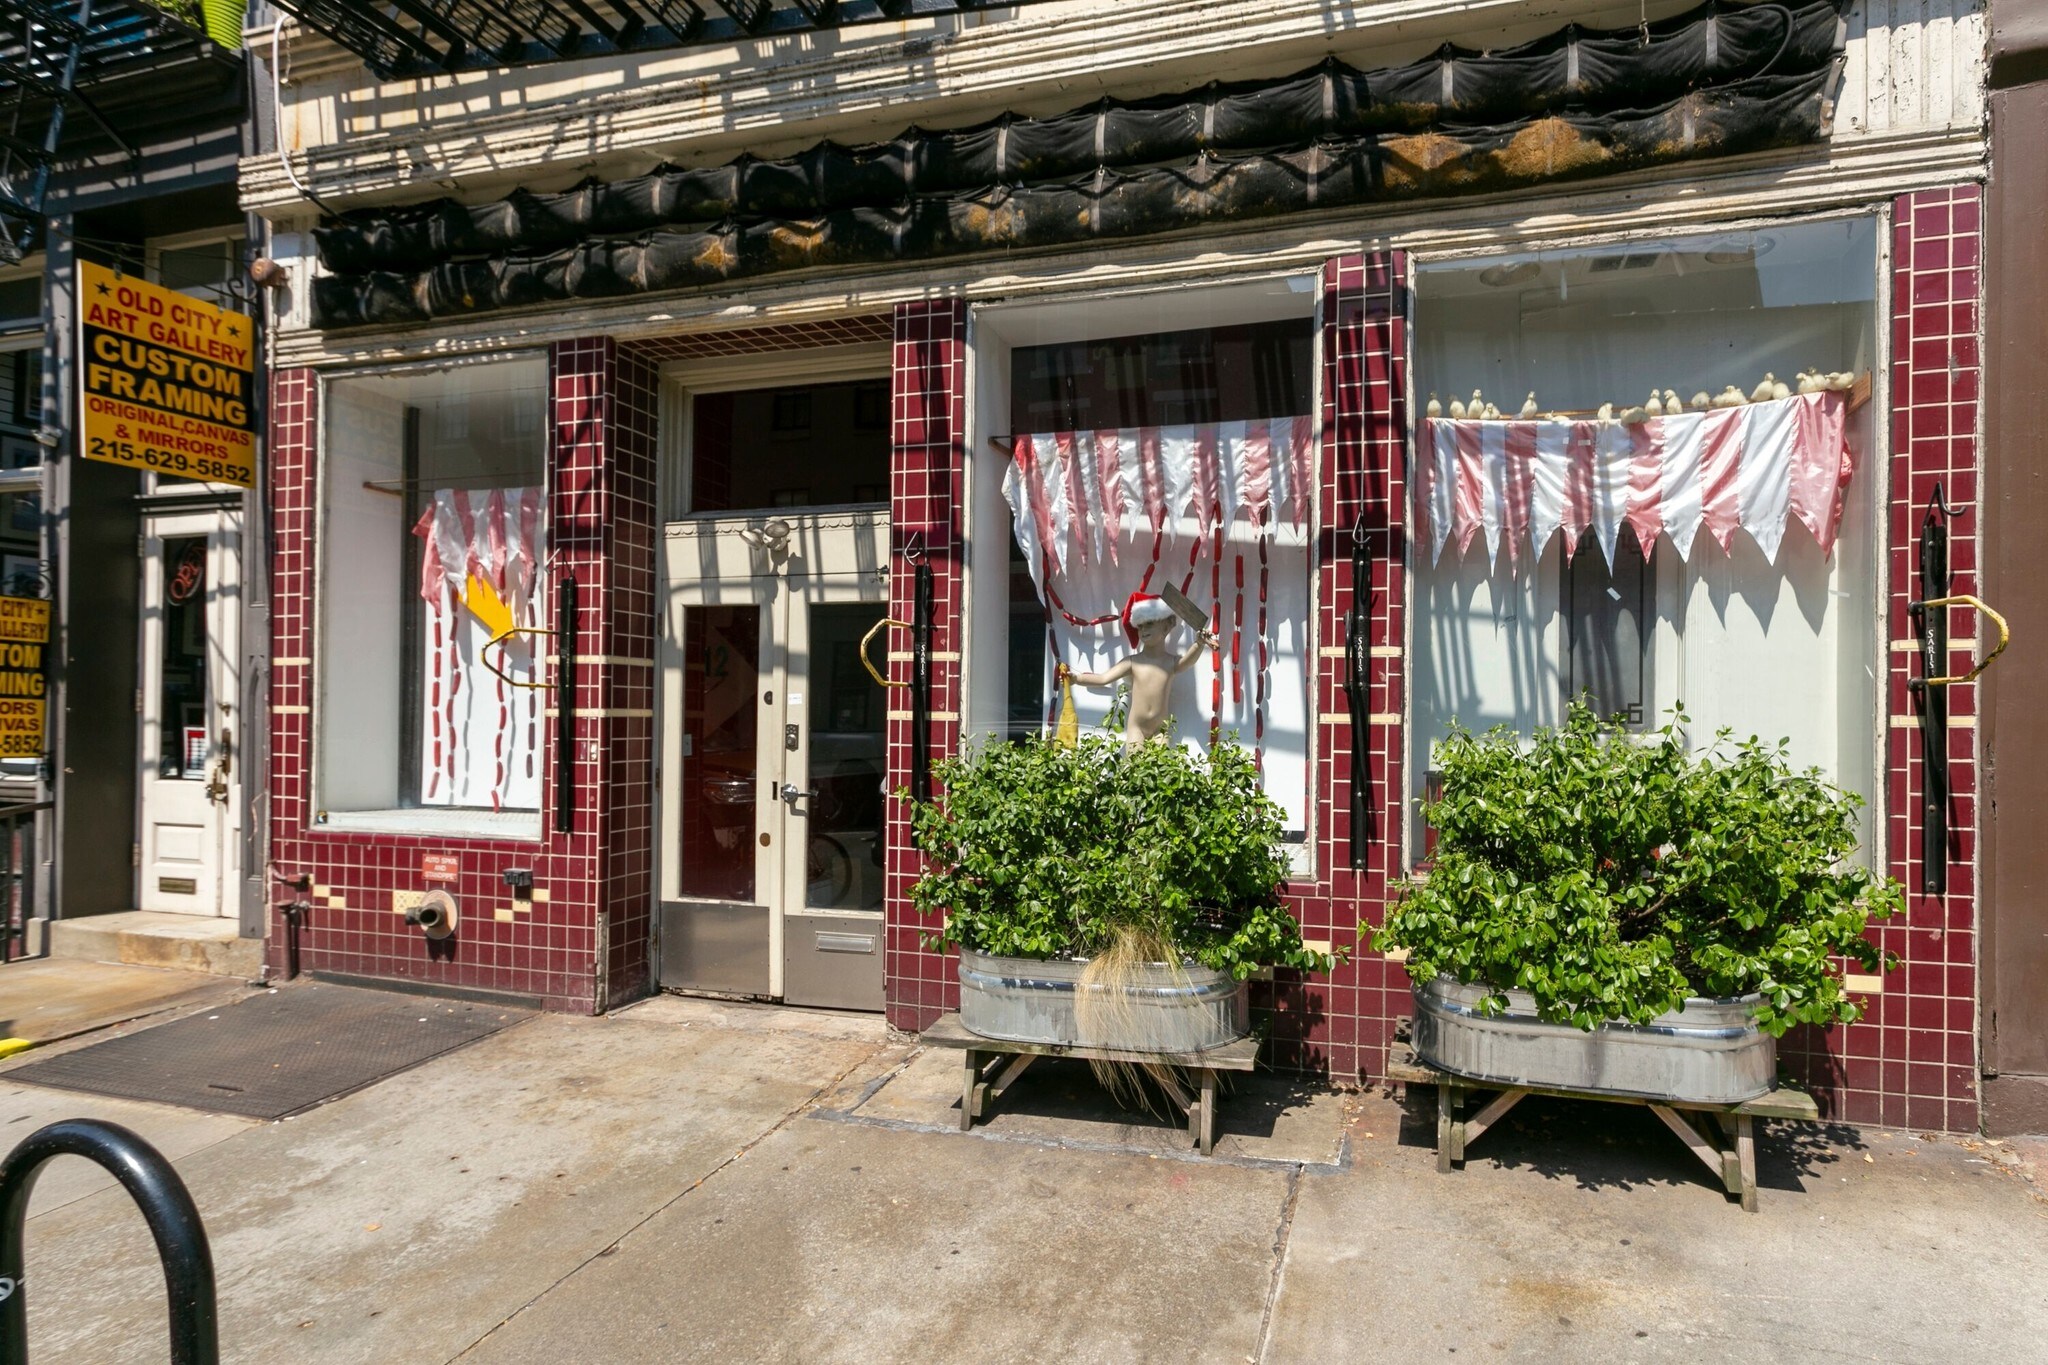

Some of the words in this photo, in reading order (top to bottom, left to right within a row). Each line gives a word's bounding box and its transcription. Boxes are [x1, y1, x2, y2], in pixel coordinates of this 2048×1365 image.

[117, 286, 164, 318] OLD
[171, 303, 223, 336] CITY
[88, 303, 139, 334] ART
[149, 321, 248, 366] GALLERY
[93, 333, 241, 397] CUSTOM
[88, 363, 247, 426] FRAMING
[90, 437, 251, 483] 215-629-5852
[115, 423, 131, 440] &
[138, 428, 229, 460] MIRRORS
[0, 620, 47, 640] LLERY
[1, 600, 35, 619] CITY
[1927, 629, 1936, 669] SARIS
[0, 718, 40, 732] VAS
